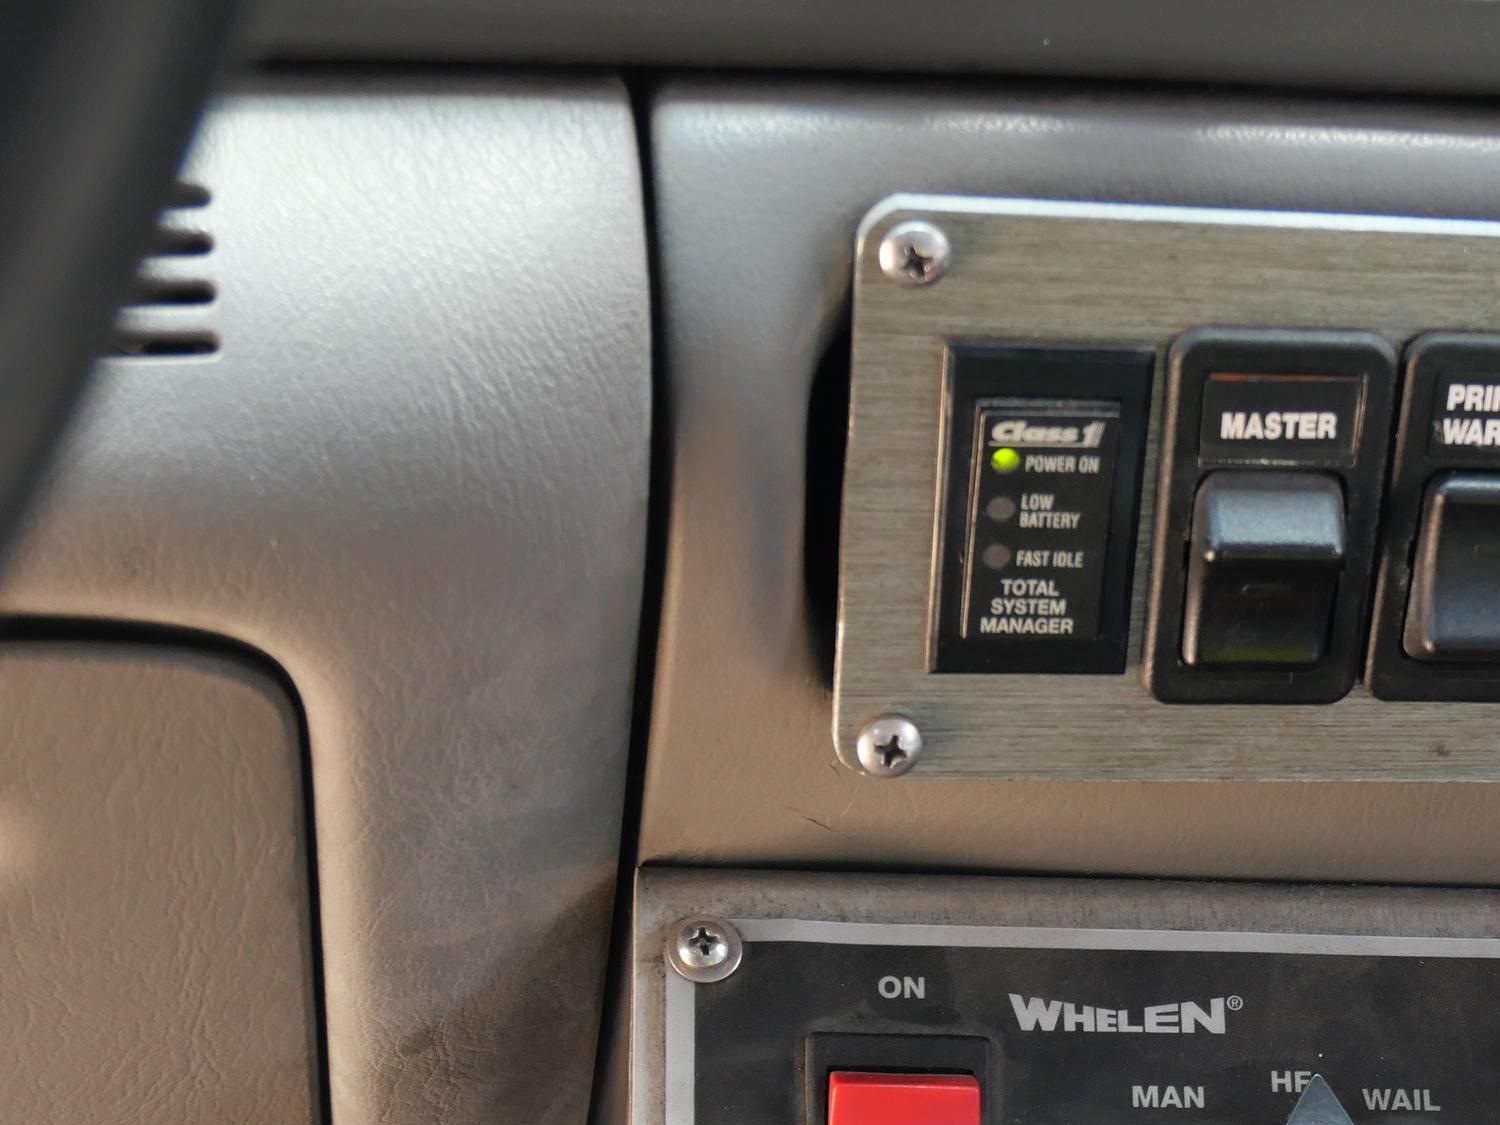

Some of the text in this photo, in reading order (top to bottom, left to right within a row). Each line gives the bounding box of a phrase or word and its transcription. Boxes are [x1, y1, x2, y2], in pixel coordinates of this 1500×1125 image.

[1220, 411, 1338, 440] MASTER
[1025, 455, 1100, 474] POWER ON
[1020, 494, 1054, 510] LOW
[1019, 512, 1081, 529] BATTERY
[1016, 551, 1085, 568] FAST IDLE
[1000, 578, 1060, 597] TOTAL
[990, 600, 1067, 615] SYSTEM
[980, 617, 1074, 634] MANAGER
[877, 975, 926, 999] ON
[1131, 1085, 1206, 1109] MAN
[1361, 1088, 1441, 1112] WAIL
